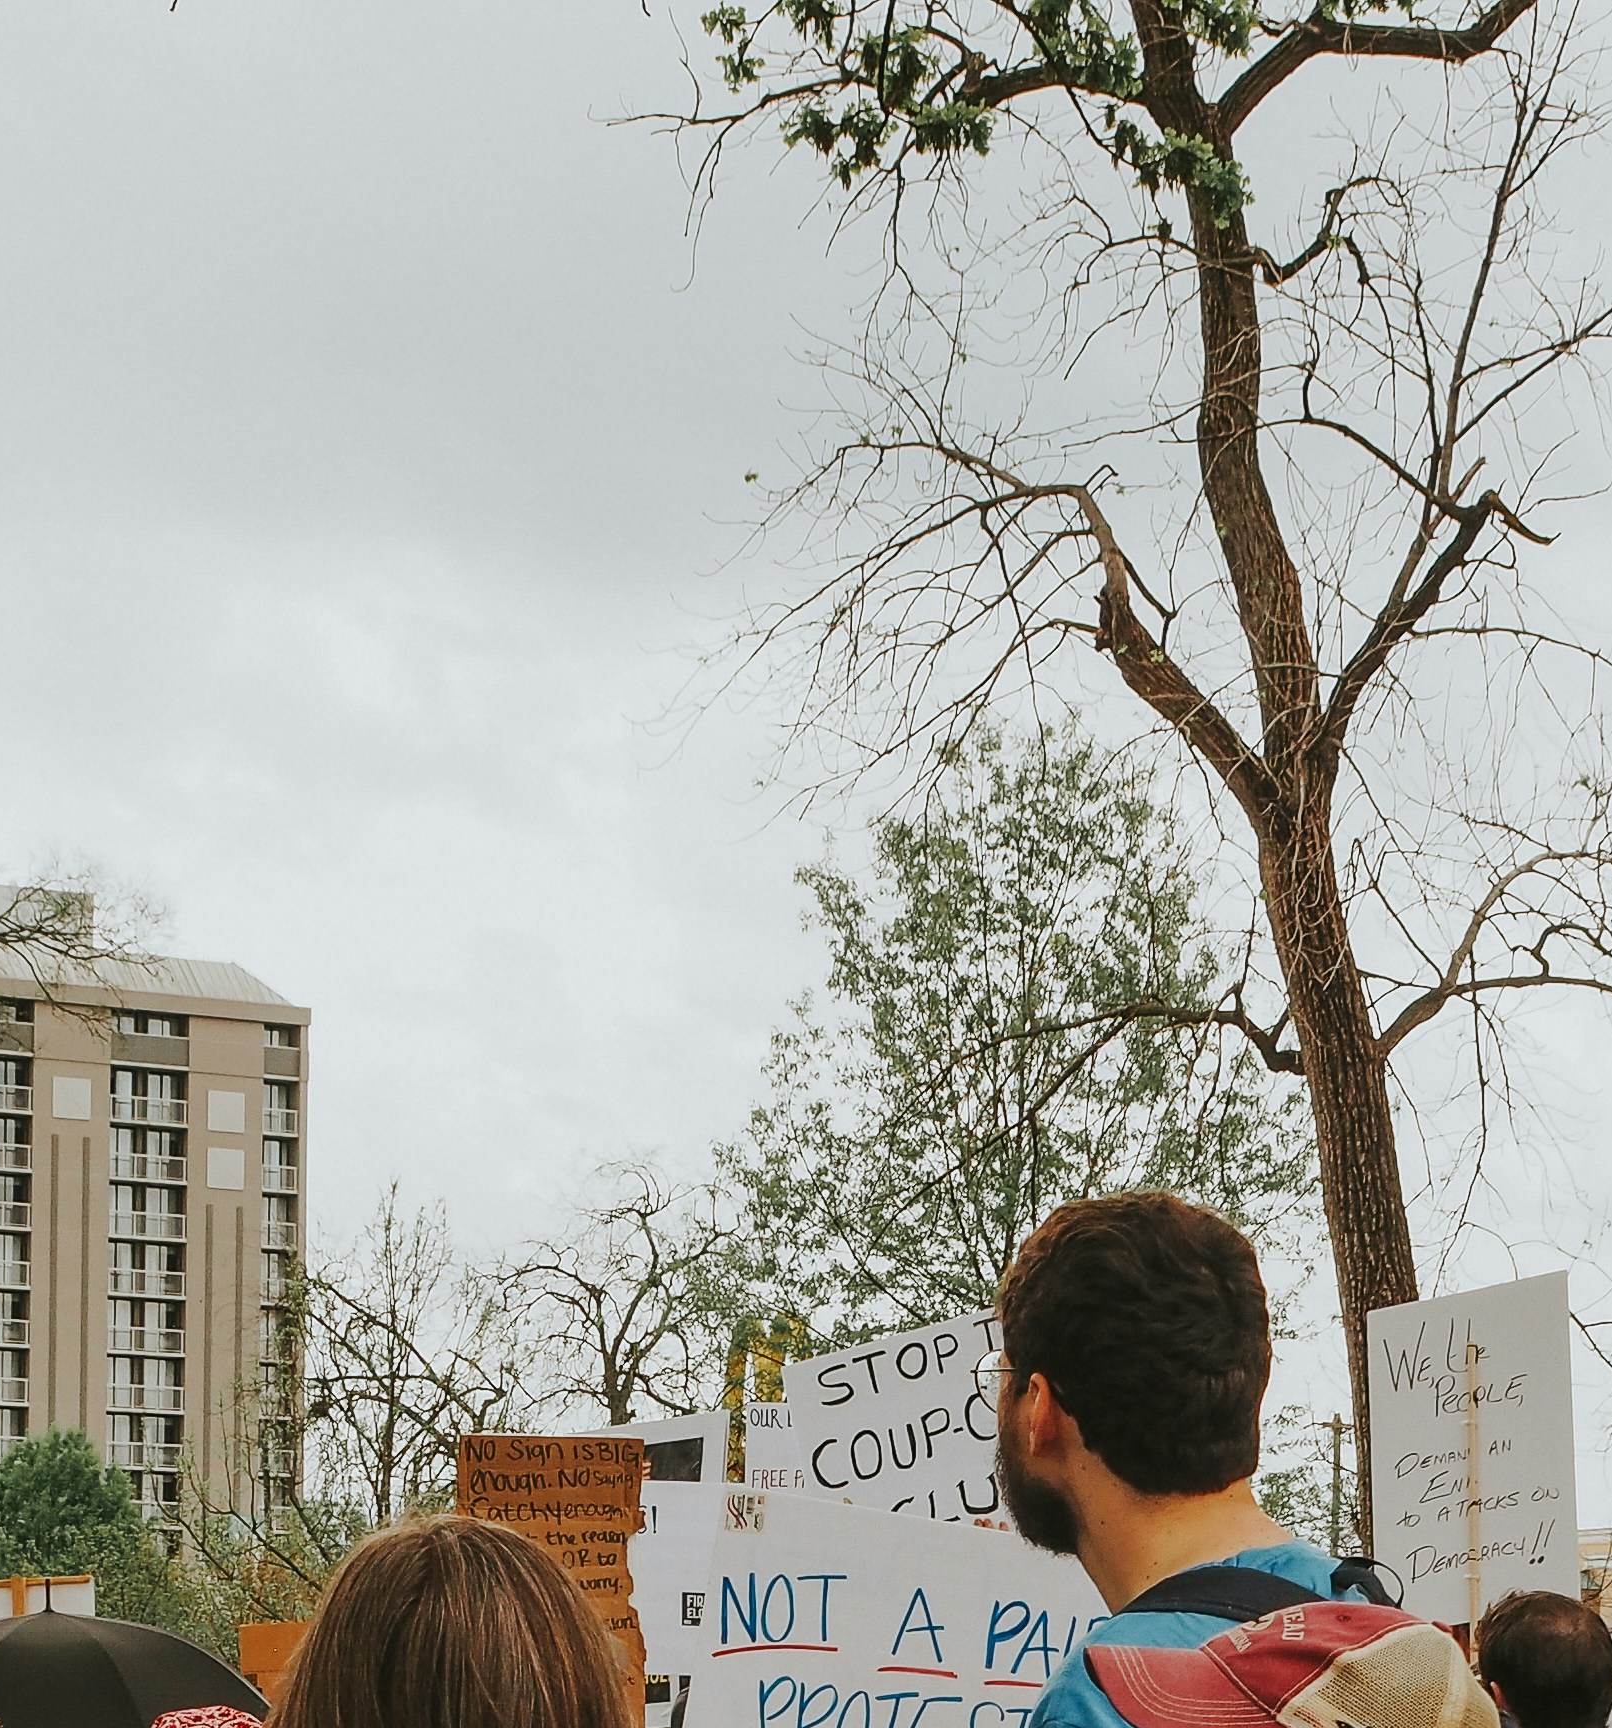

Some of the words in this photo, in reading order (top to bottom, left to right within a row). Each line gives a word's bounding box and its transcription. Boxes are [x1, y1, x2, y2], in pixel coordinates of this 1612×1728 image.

[817, 1333, 958, 1405] STOP
[750, 1408, 783, 1429] OUR
[596, 1442, 639, 1470] BIG
[1489, 1439, 1512, 1455] AN
[752, 1469, 788, 1489] FREE
[1531, 1486, 1560, 1502] ON
[721, 1573, 847, 1644] NOT
[892, 1587, 944, 1662] A
[985, 1600, 1110, 1677] PAI
